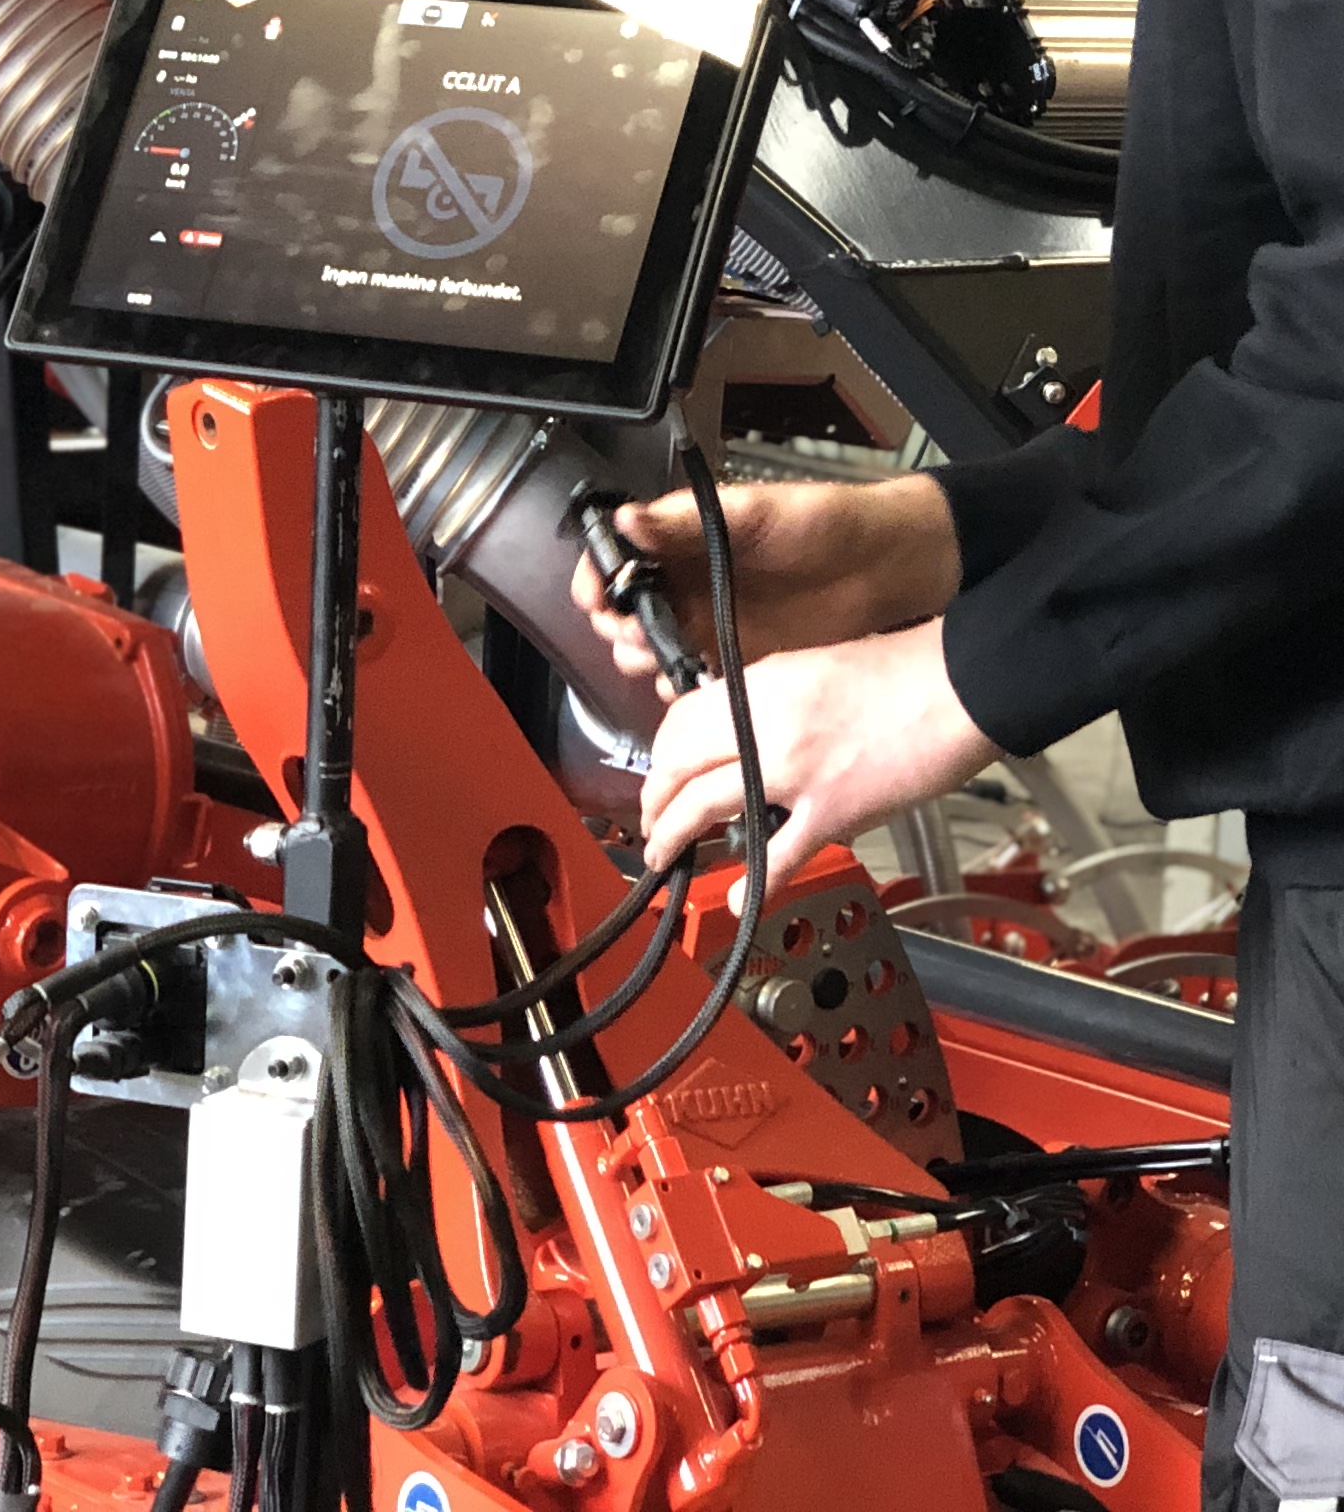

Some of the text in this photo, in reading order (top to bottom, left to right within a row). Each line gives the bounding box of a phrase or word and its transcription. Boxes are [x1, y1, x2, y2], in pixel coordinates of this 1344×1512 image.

[505, 76, 521, 95] A
[320, 265, 369, 287] Ingen
[370, 272, 438, 292] maskine
[663, 1080, 775, 1123] KUHN
